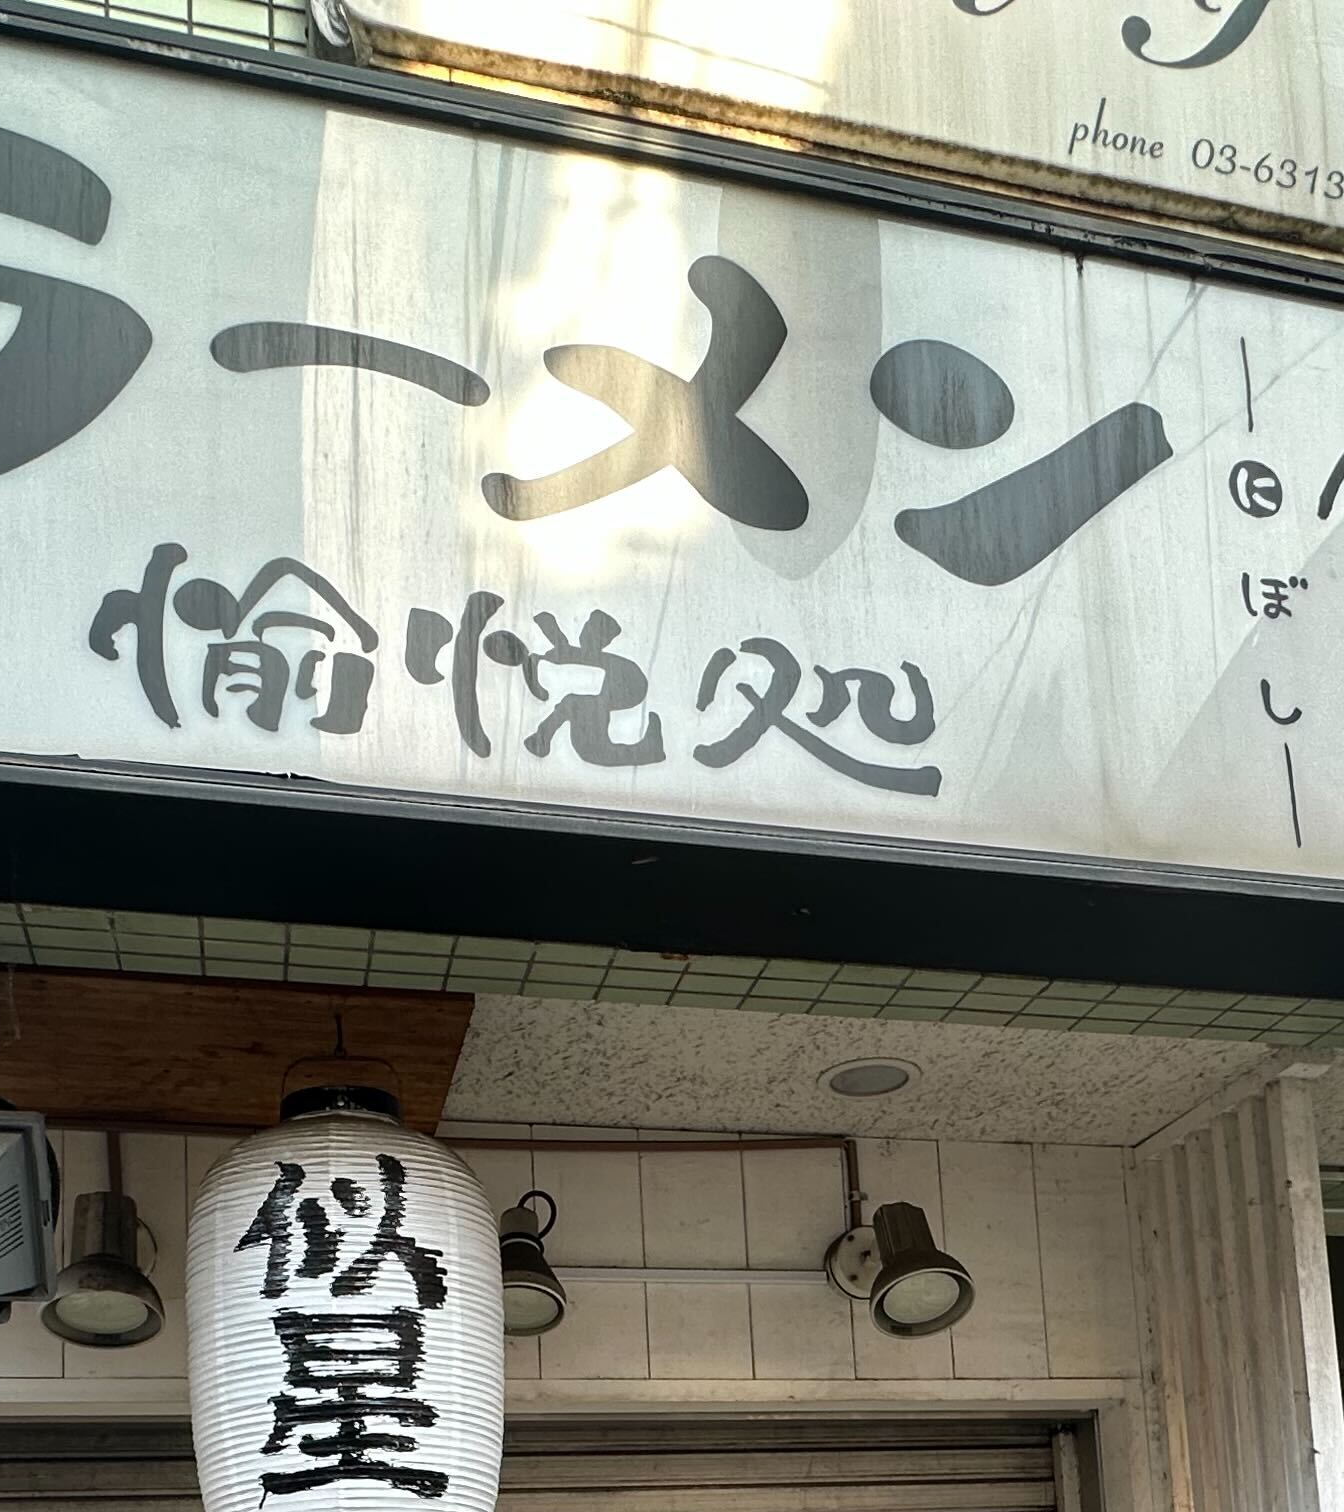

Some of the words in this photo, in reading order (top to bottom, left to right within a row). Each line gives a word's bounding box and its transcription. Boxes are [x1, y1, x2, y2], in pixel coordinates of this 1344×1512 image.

[1068, 97, 1164, 161] phone
[89, 543, 941, 798] 愉悦処
[236, 1153, 449, 1509] 似星
